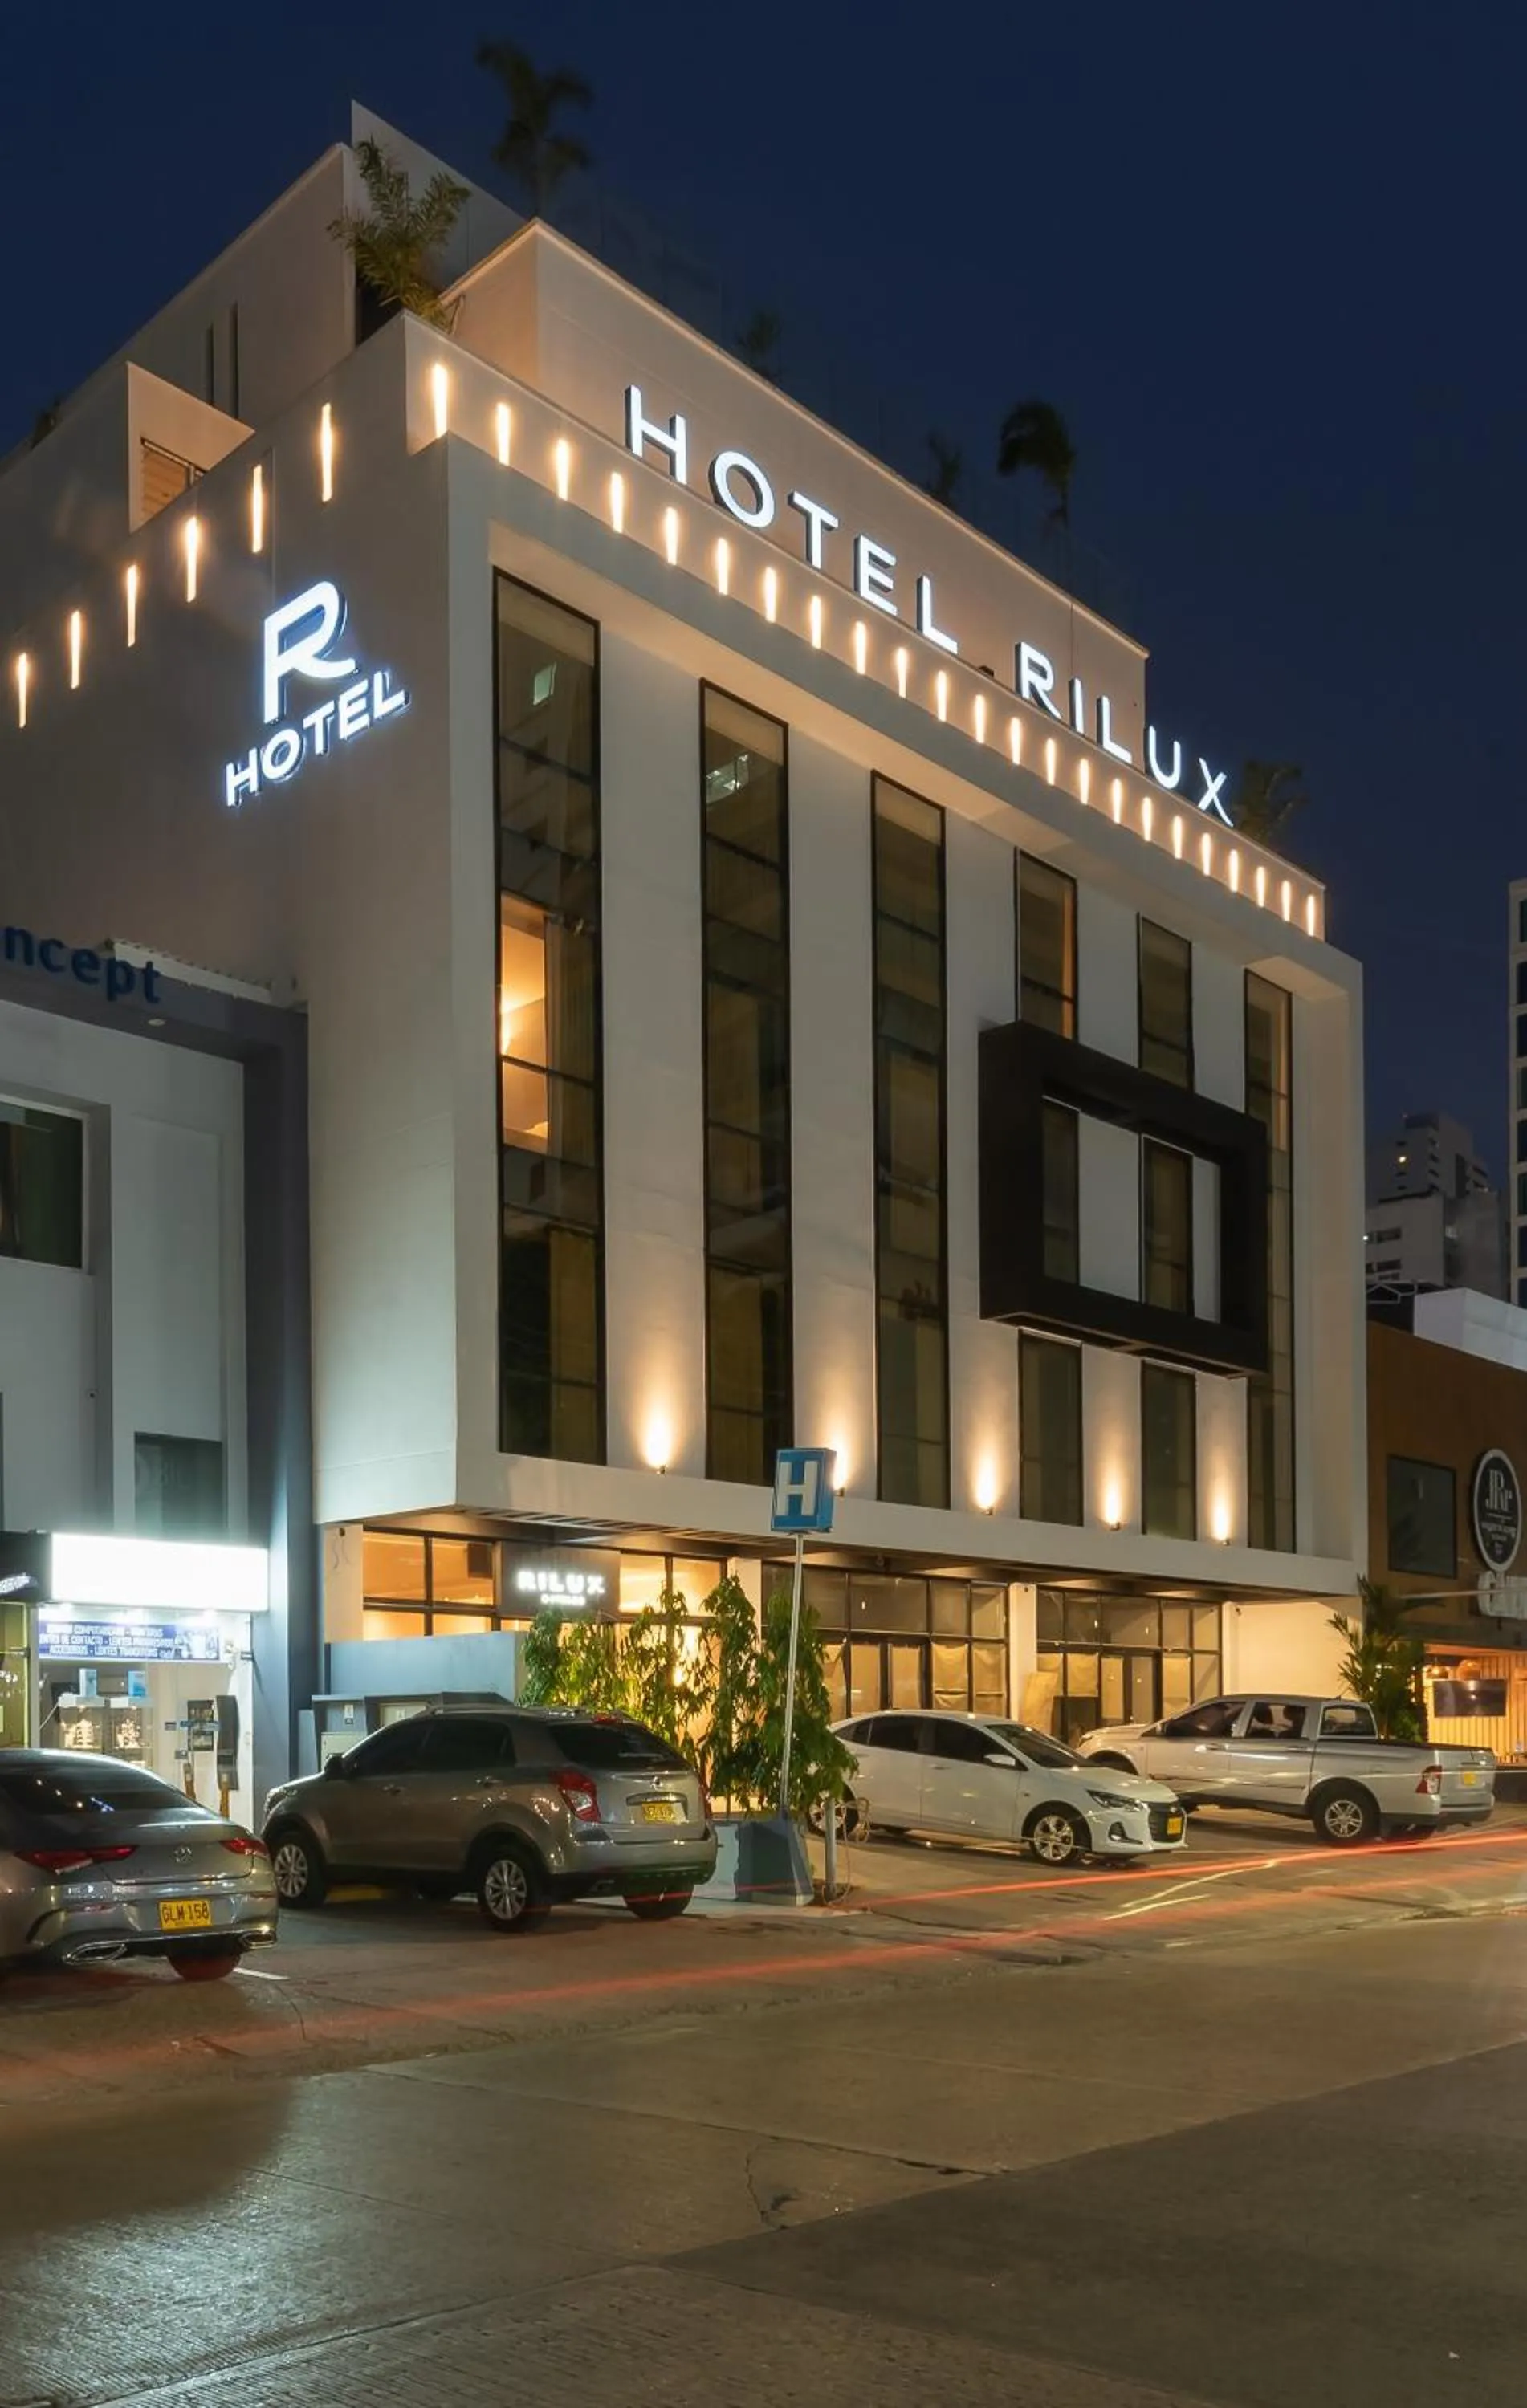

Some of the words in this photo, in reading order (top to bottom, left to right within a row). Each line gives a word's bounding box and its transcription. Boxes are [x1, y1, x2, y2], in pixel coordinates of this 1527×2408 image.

[263, 580, 356, 724] R
[625, 384, 959, 655] HOTEL
[1015, 641, 1234, 828] RILUX
[226, 670, 408, 807] HOTEL
[775, 1460, 818, 1516] H
[516, 1570, 605, 1595] RILUX
